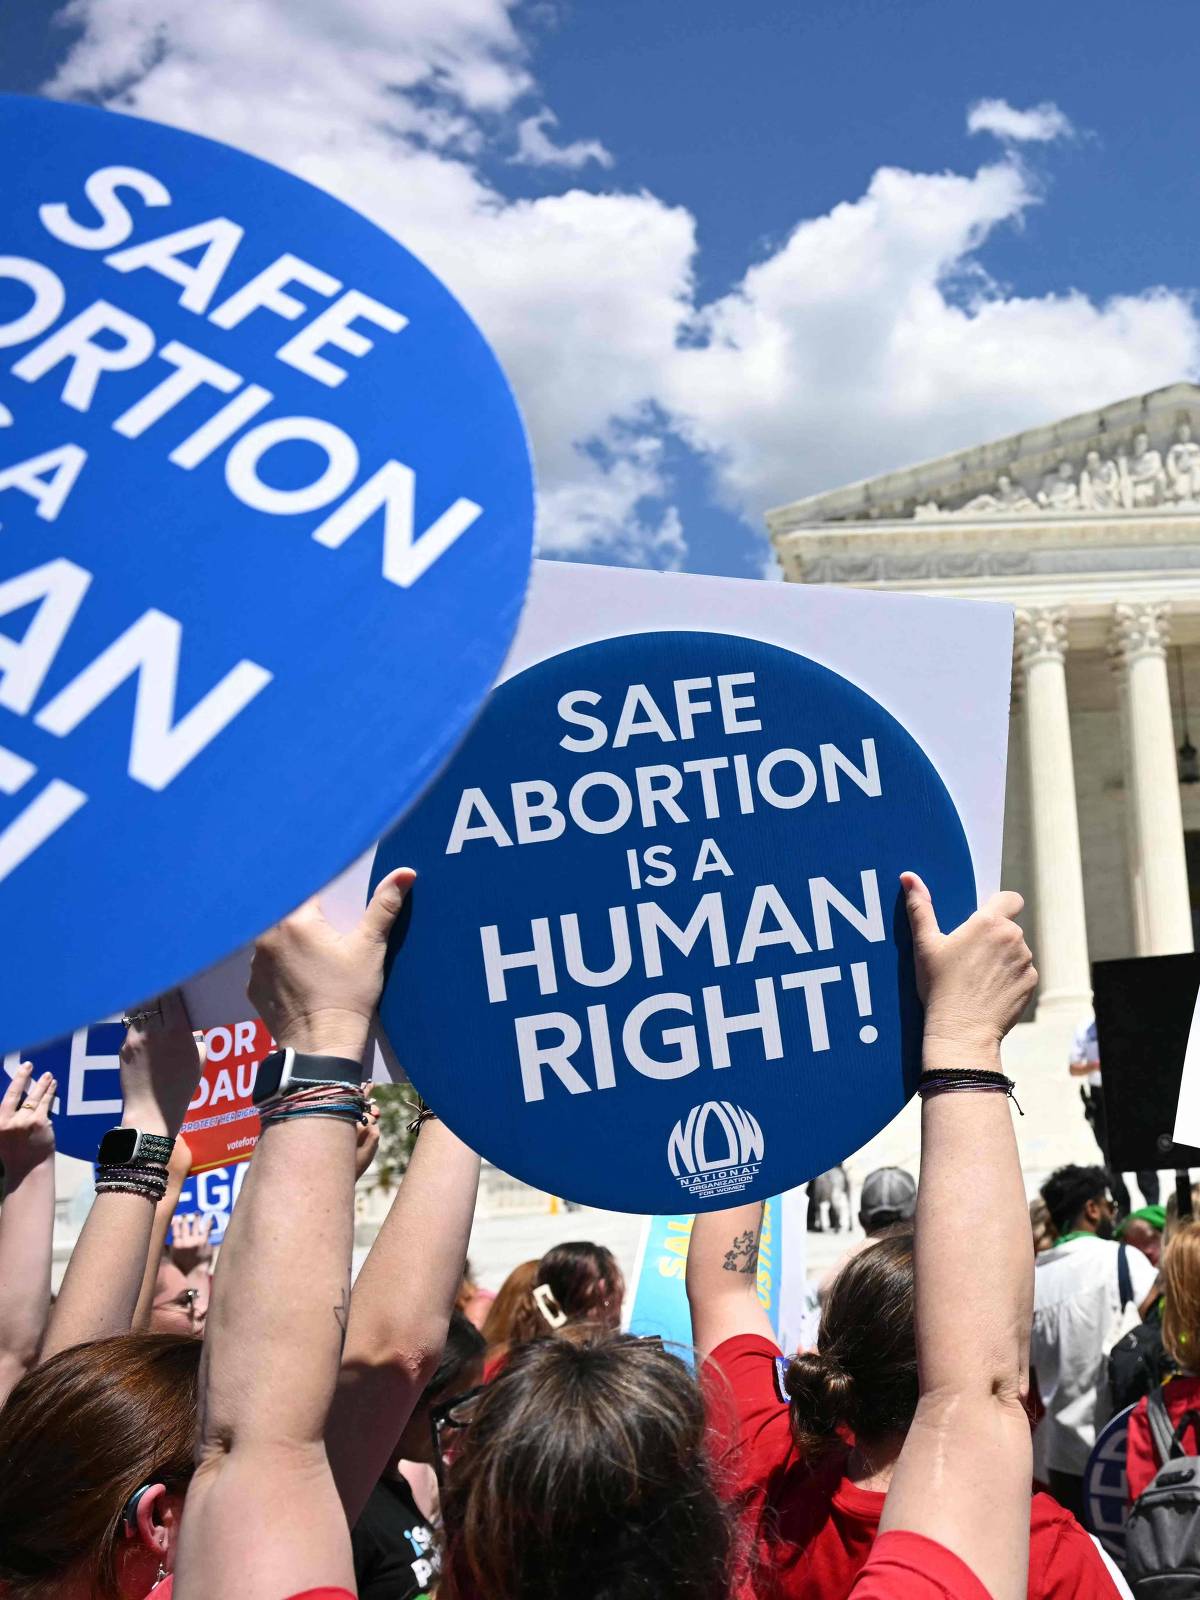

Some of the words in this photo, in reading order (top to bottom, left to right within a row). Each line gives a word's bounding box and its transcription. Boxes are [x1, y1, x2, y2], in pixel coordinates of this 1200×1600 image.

[38, 165, 410, 388] SAFE
[556, 671, 762, 753] SAFE
[445, 738, 882, 856] ABORTION
[626, 845, 677, 890] IS
[692, 838, 734, 882] A
[479, 869, 886, 1004] HUMAN
[514, 961, 879, 1103] RIGHT!
[668, 1101, 764, 1177] NOW
[680, 1166, 760, 1186] NATIONAL
[689, 1175, 753, 1192] ORGANIZATION
[699, 1189, 714, 1197] FOR
[716, 1184, 746, 1194] WOMEN
